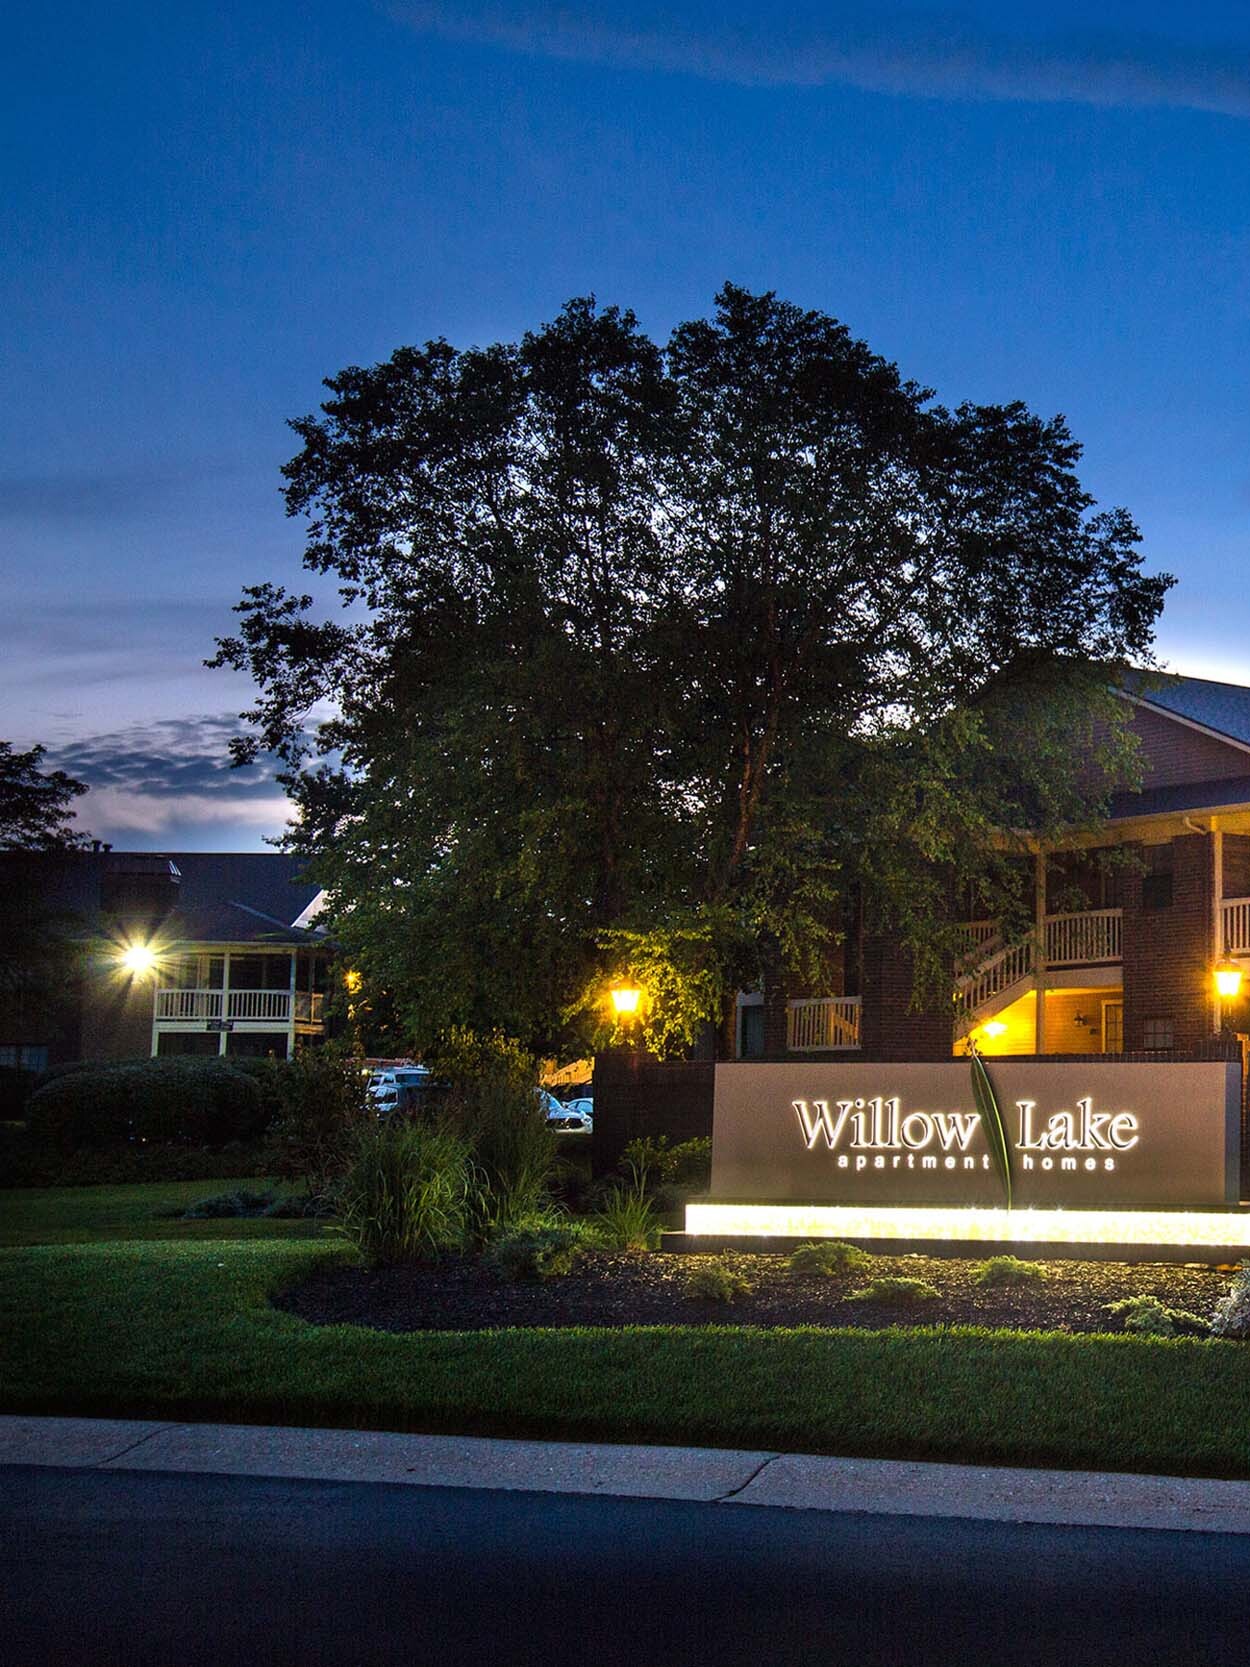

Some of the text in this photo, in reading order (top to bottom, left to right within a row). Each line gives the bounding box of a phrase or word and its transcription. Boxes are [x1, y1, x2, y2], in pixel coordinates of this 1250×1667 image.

[793, 1097, 1139, 1150] Willow Lake
[837, 1153, 1117, 1171] apartment homes
